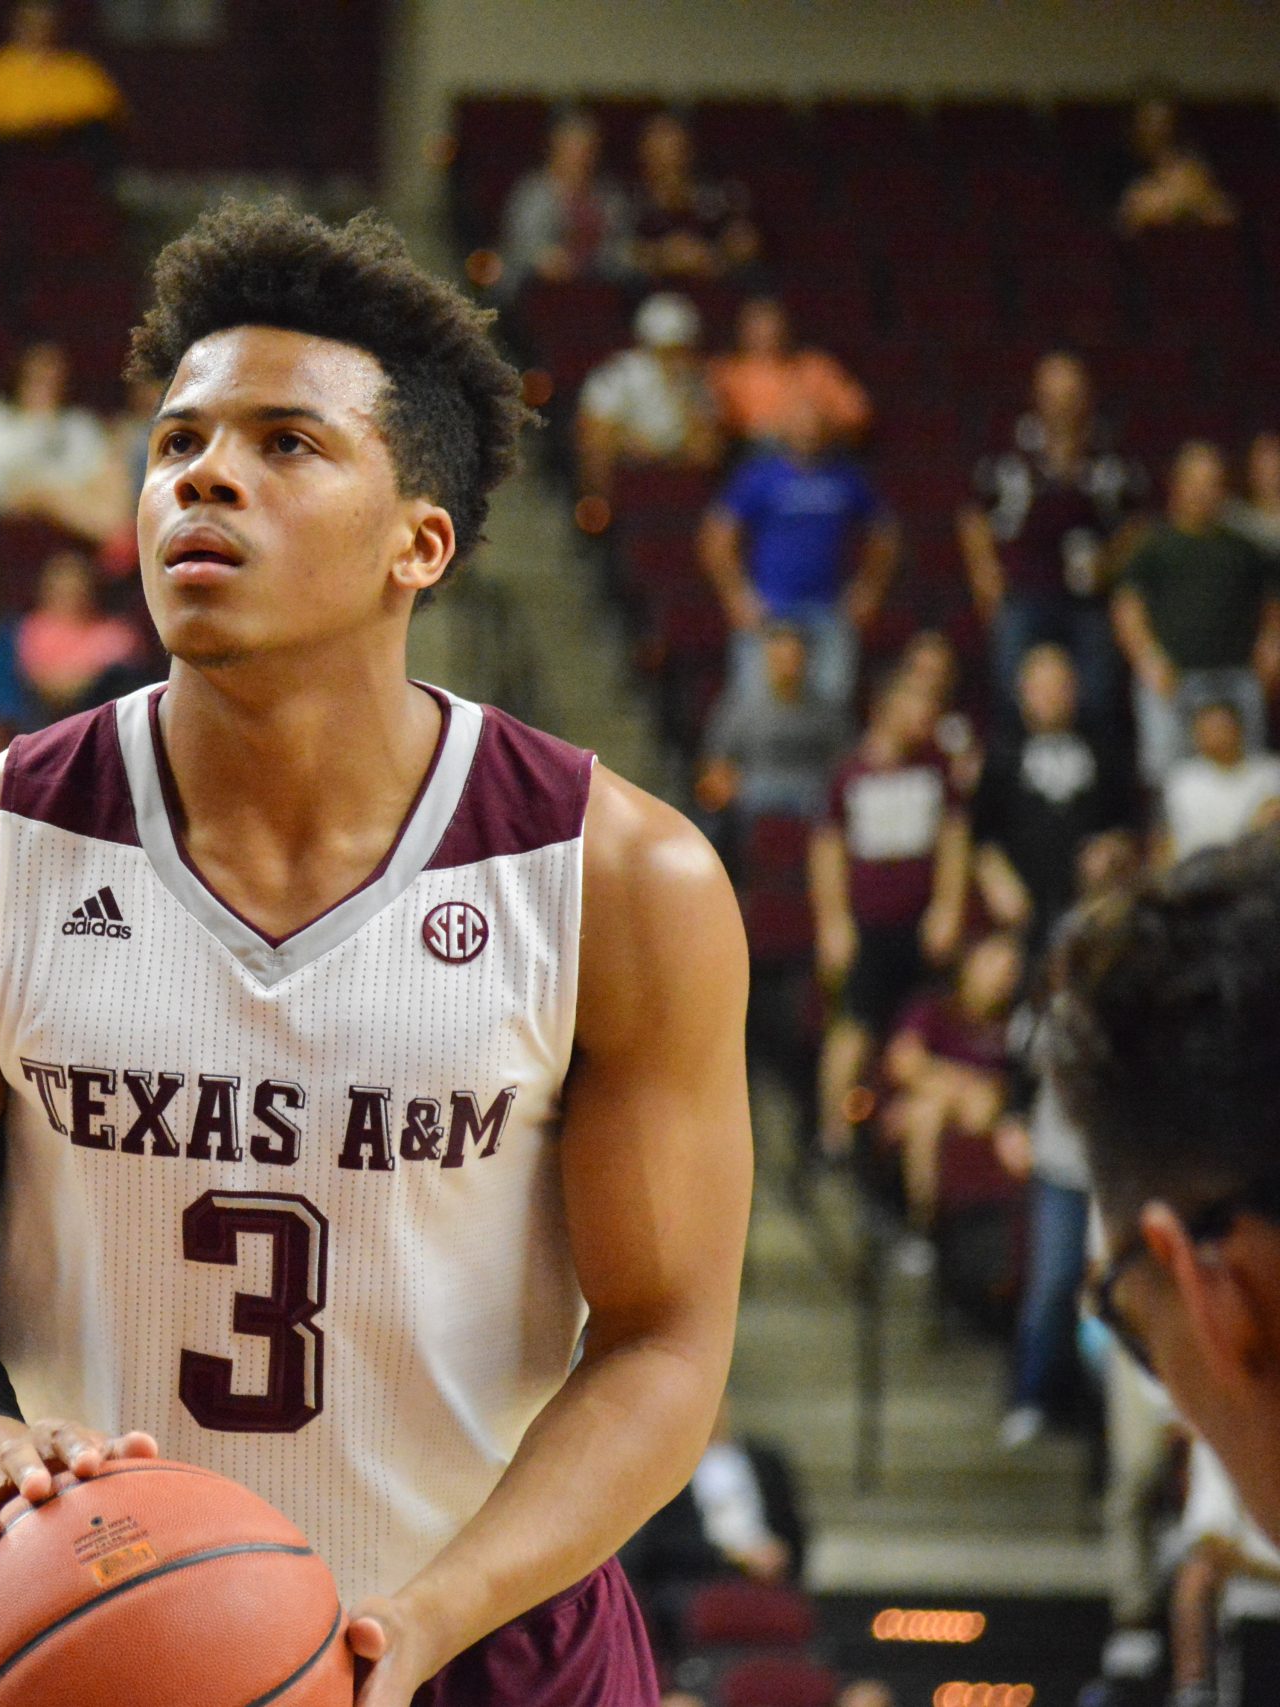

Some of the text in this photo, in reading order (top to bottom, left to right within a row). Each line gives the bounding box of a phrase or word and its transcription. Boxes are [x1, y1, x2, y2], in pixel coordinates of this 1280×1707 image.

[62, 917, 131, 939] adidas
[427, 905, 484, 959] SEC
[20, 1056, 518, 1171] TEXAS A&M
[178, 1189, 329, 1433] 3
